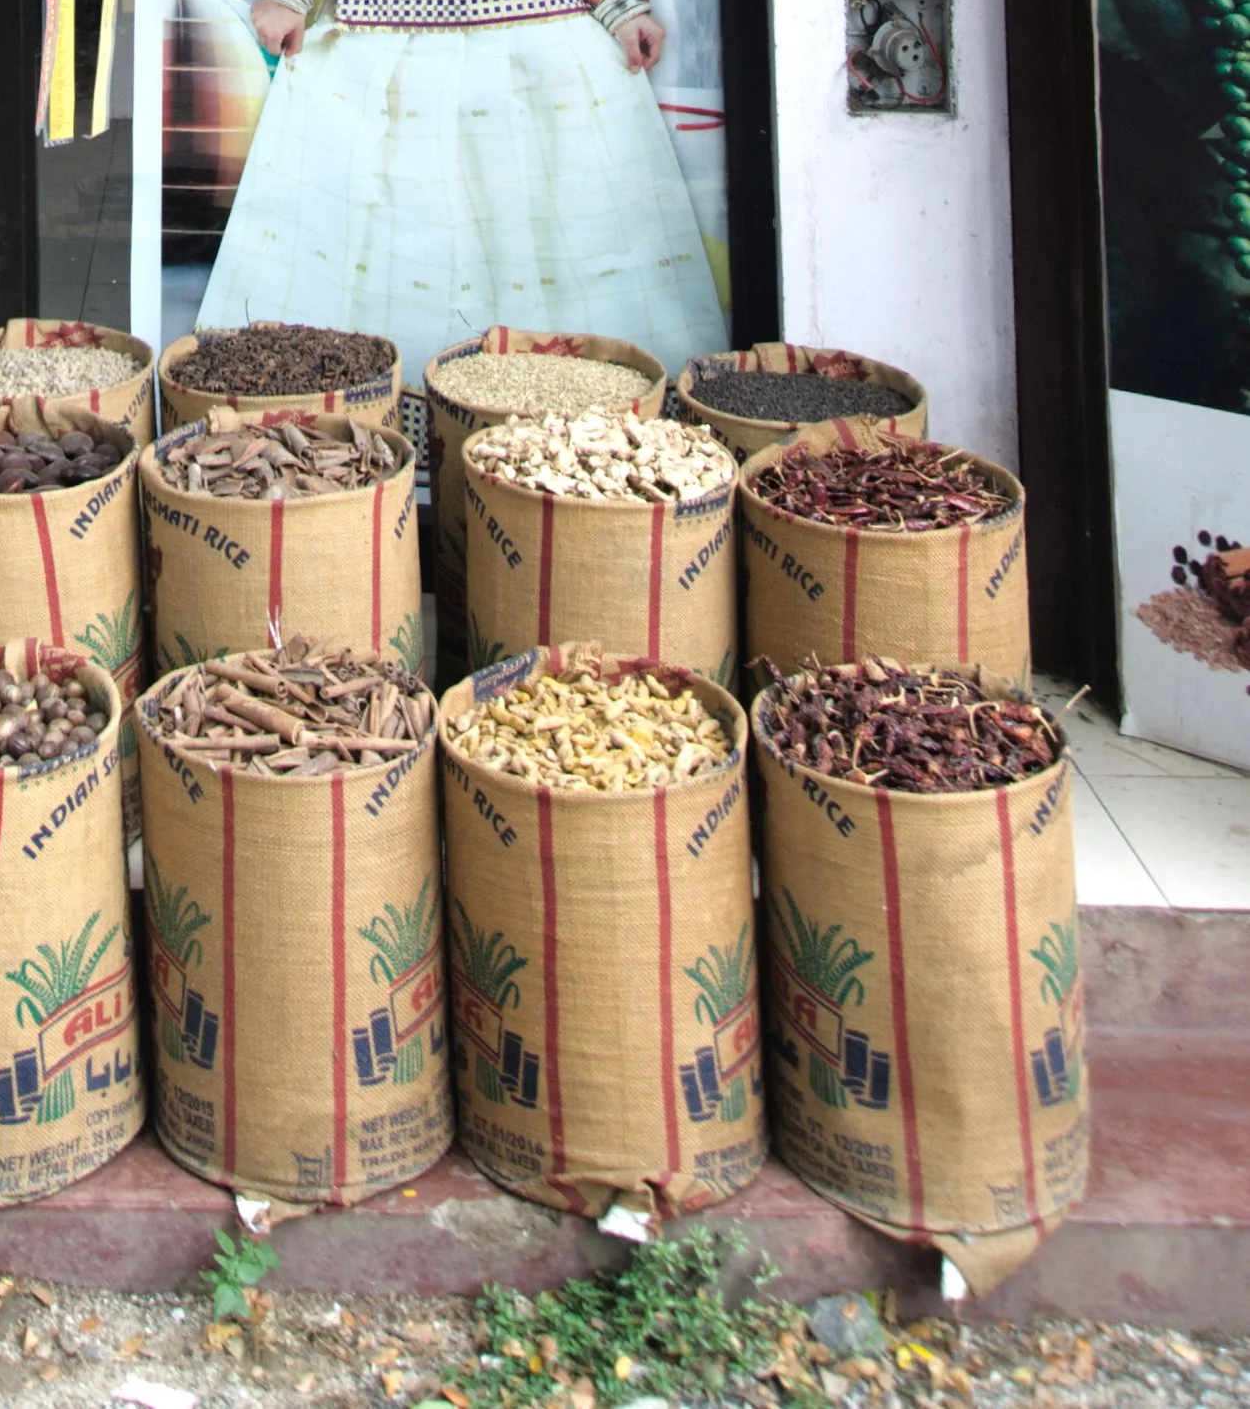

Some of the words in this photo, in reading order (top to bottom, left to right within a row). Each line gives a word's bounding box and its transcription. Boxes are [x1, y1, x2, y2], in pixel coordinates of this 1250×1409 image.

[69, 477, 123, 540] INDIAN
[205, 525, 251, 569] RICE
[487, 516, 522, 569] RICE
[677, 520, 733, 591] INDIAN
[781, 553, 825, 602] RICE
[164, 744, 204, 804] RICE
[22, 767, 101, 860] INDIAN
[472, 788, 518, 847] RICE
[686, 780, 741, 858] INDIAN
[801, 776, 856, 838] RICE
[63, 990, 122, 1047] ALI
[29, 1135, 82, 1166] WEIGHT
